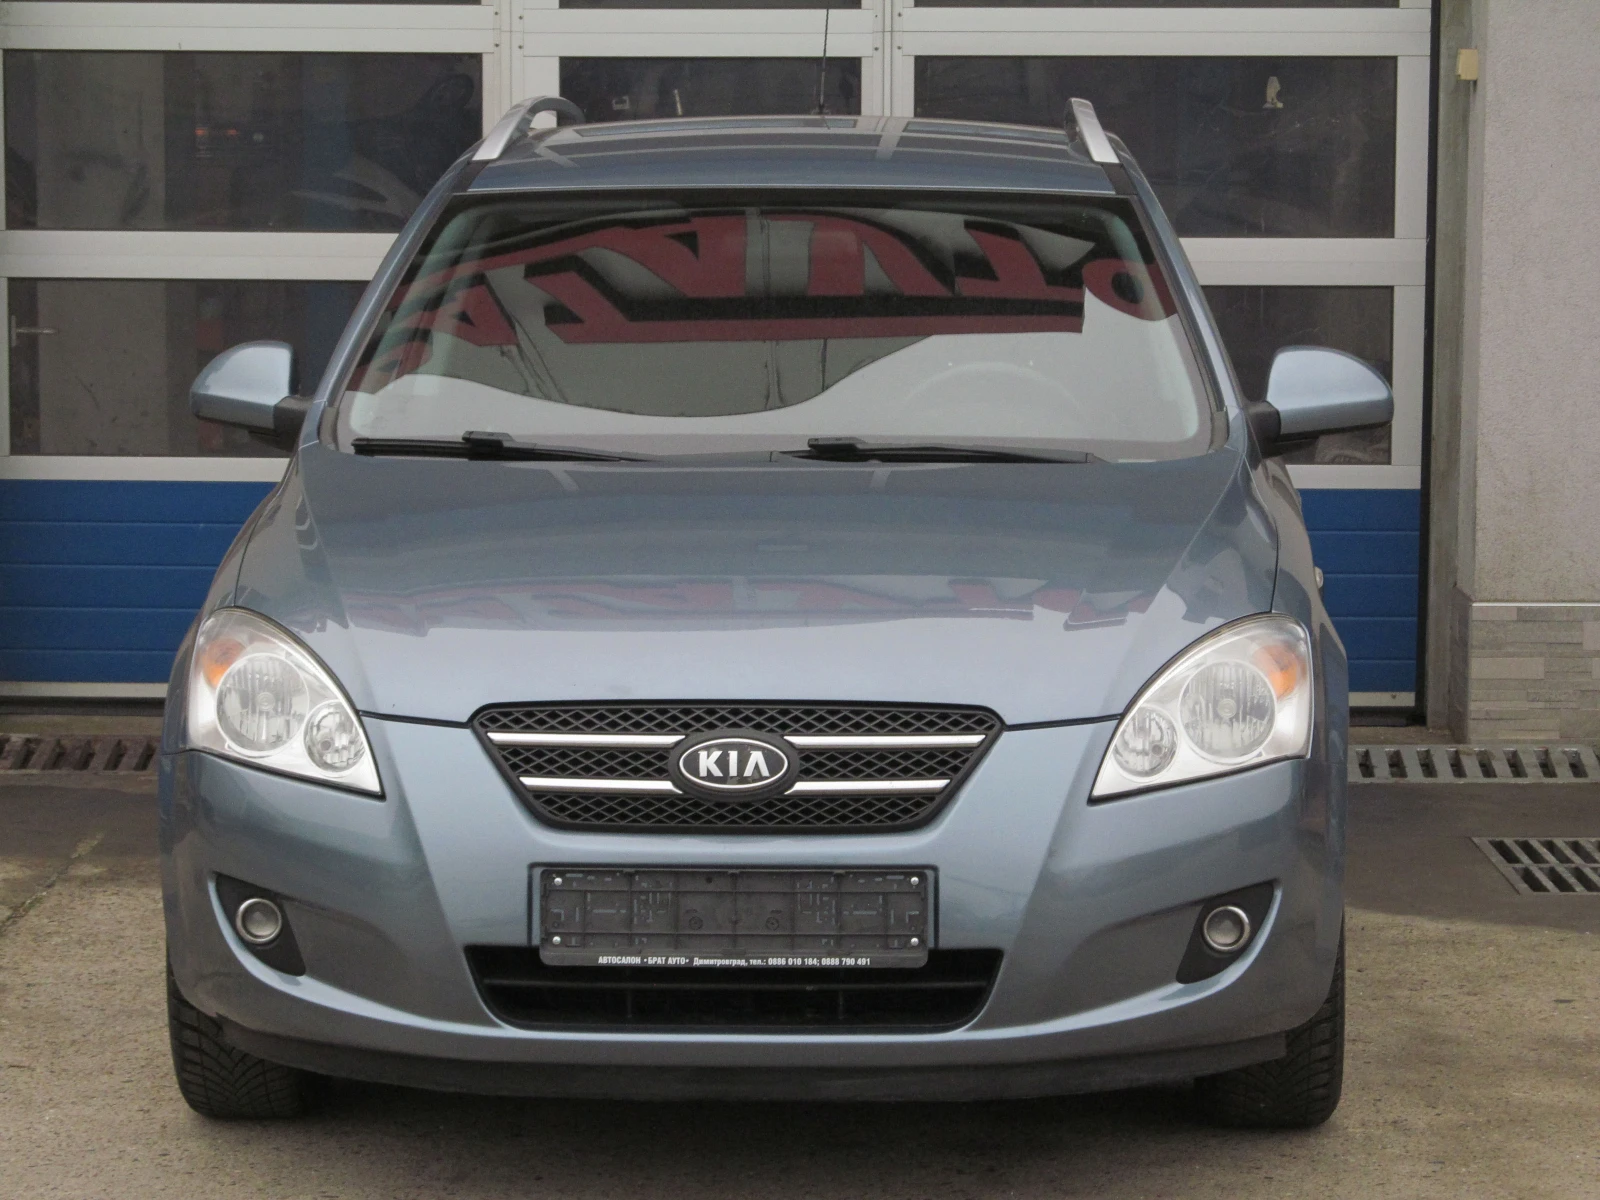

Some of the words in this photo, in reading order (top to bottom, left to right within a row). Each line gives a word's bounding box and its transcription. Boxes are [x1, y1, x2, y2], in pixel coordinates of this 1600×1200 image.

[698, 750, 770, 777] KIA
[597, 955, 642, 965] АВТОСАЛОН
[693, 957, 749, 967] Димитровград,
[787, 957, 802, 966] 010
[841, 957, 856, 966] 790
[857, 957, 871, 966] 491
